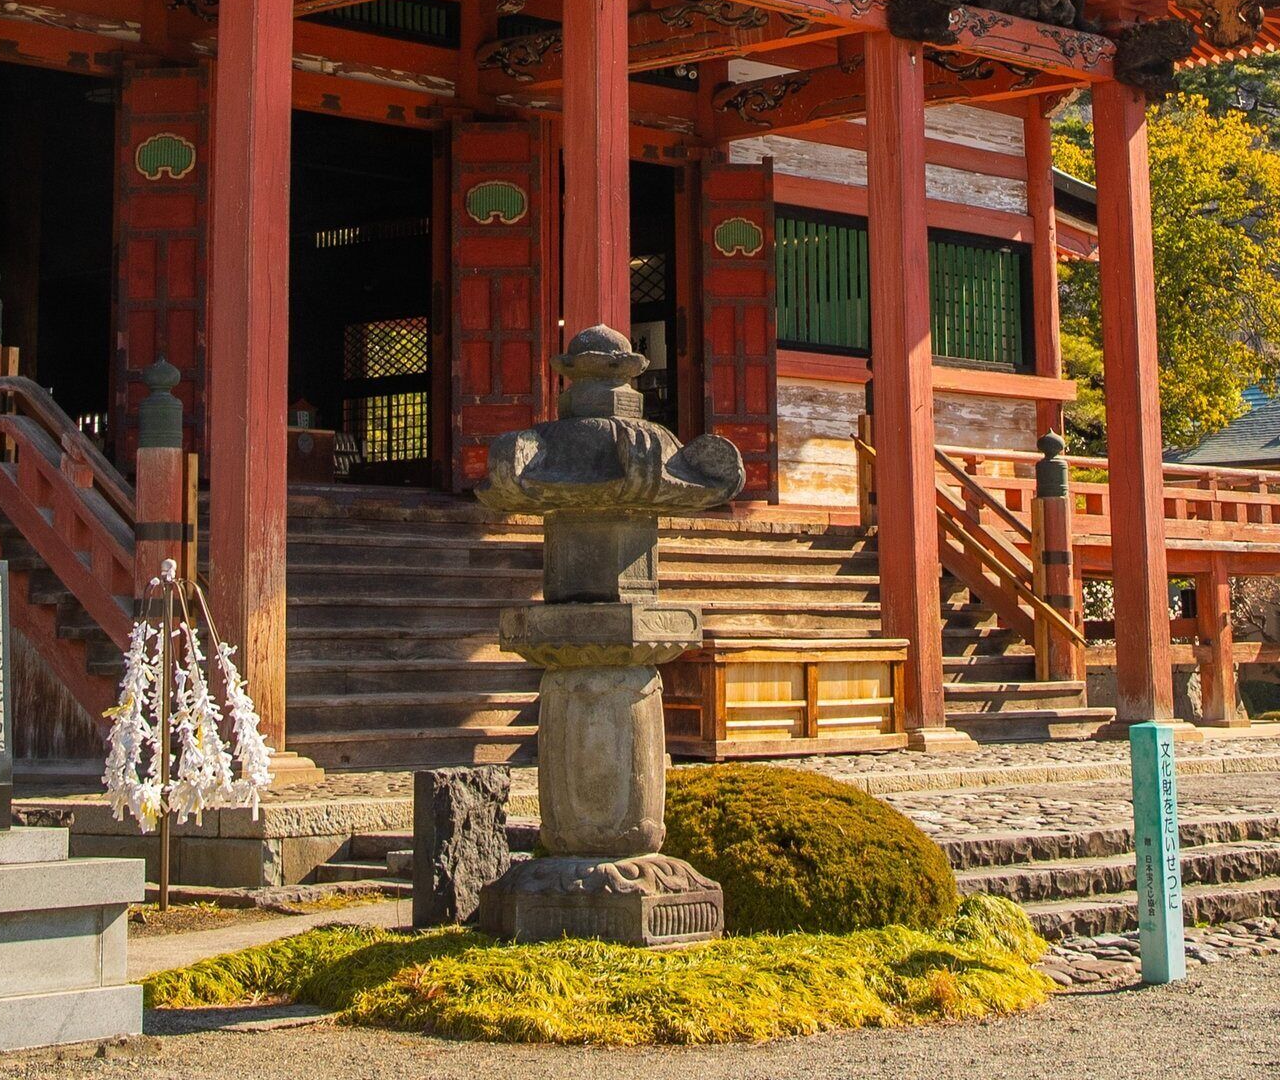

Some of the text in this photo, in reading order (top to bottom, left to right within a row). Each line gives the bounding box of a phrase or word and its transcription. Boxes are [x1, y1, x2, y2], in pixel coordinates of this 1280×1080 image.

[1160, 741, 1179, 910] 文化財をたいせつに
